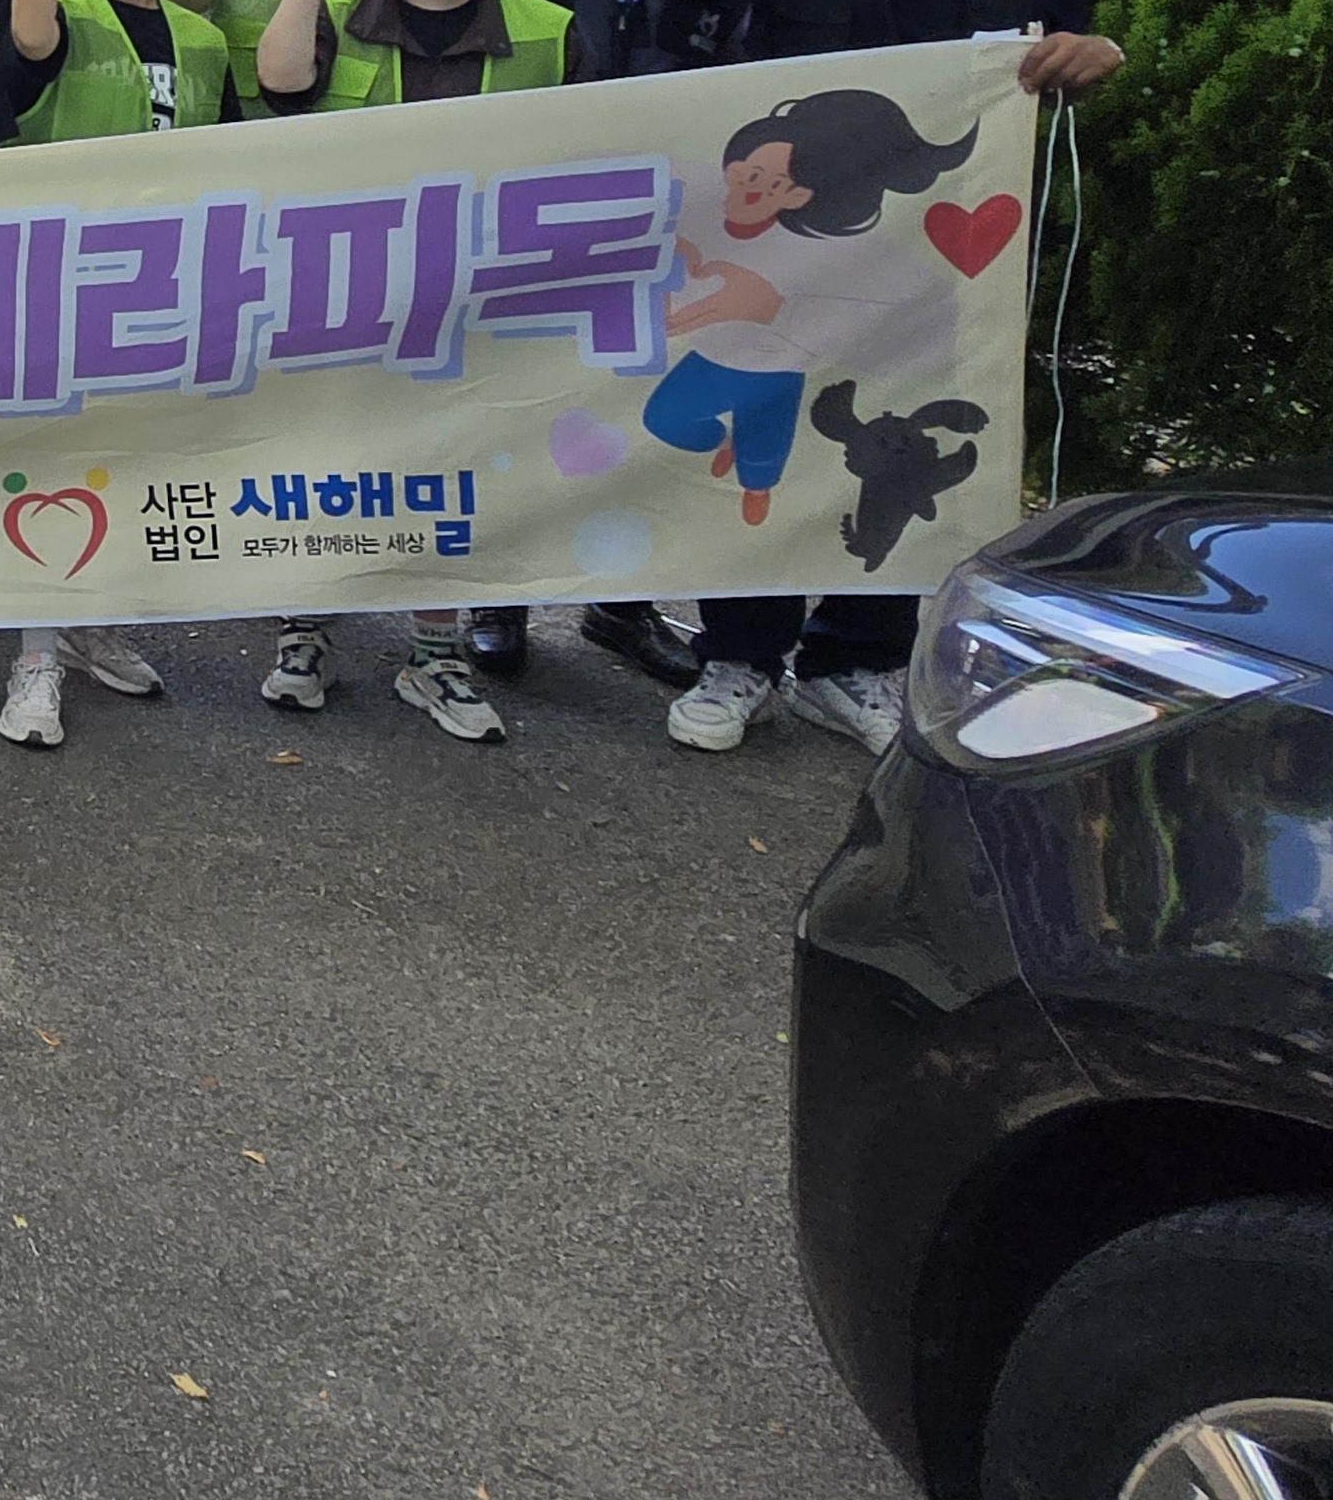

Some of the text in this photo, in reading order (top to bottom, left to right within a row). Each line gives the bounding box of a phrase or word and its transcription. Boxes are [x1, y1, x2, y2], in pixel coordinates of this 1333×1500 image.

[140, 481, 217, 521] 사단
[229, 469, 476, 557] 새해밀
[144, 523, 221, 562] 법인
[241, 531, 426, 558] 모두가 함께하는 세상
